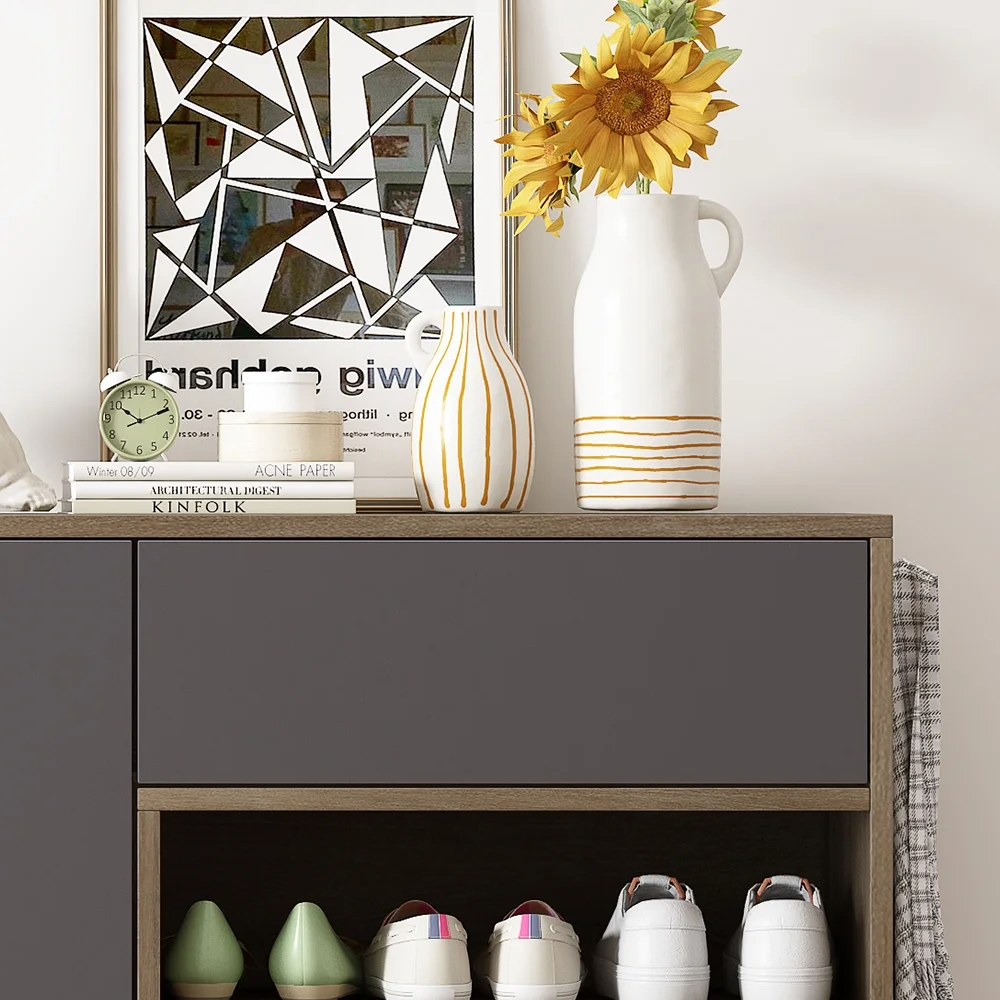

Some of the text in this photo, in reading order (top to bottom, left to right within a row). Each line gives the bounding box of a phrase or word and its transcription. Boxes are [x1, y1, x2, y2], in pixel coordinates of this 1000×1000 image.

[120, 389, 133, 399] 11
[133, 386, 146, 396] 12
[151, 389, 157, 399] 1
[109, 401, 123, 410] 10
[104, 413, 112, 423] 9
[169, 414, 175, 424] 3
[109, 429, 116, 439] 8
[162, 431, 169, 440] 4
[120, 440, 127, 450] 7
[151, 442, 157, 451] 5
[136, 446, 143, 455] 6
[86, 466, 155, 478] Winter 08/09
[254, 464, 336, 477] ACNE PAPER
[150, 486, 282, 496] ARCHITECTURAL DIGEST
[152, 501, 247, 513] KINFOLK
